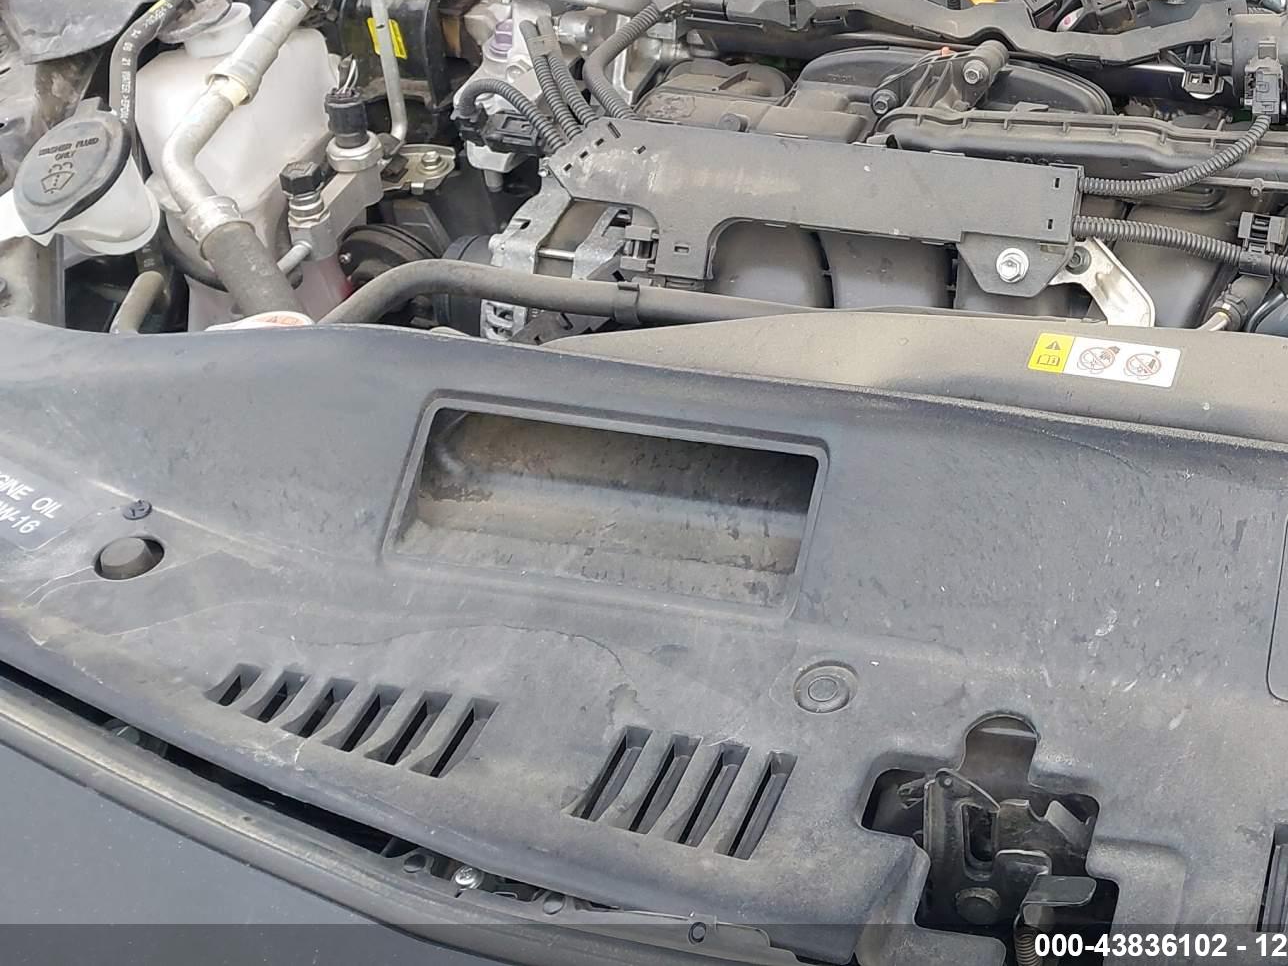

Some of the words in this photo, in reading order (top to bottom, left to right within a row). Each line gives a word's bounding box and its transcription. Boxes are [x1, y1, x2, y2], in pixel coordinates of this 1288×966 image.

[0, 474, 35, 501] GINE
[31, 497, 62, 519] OIL
[0, 500, 40, 534] W-16
